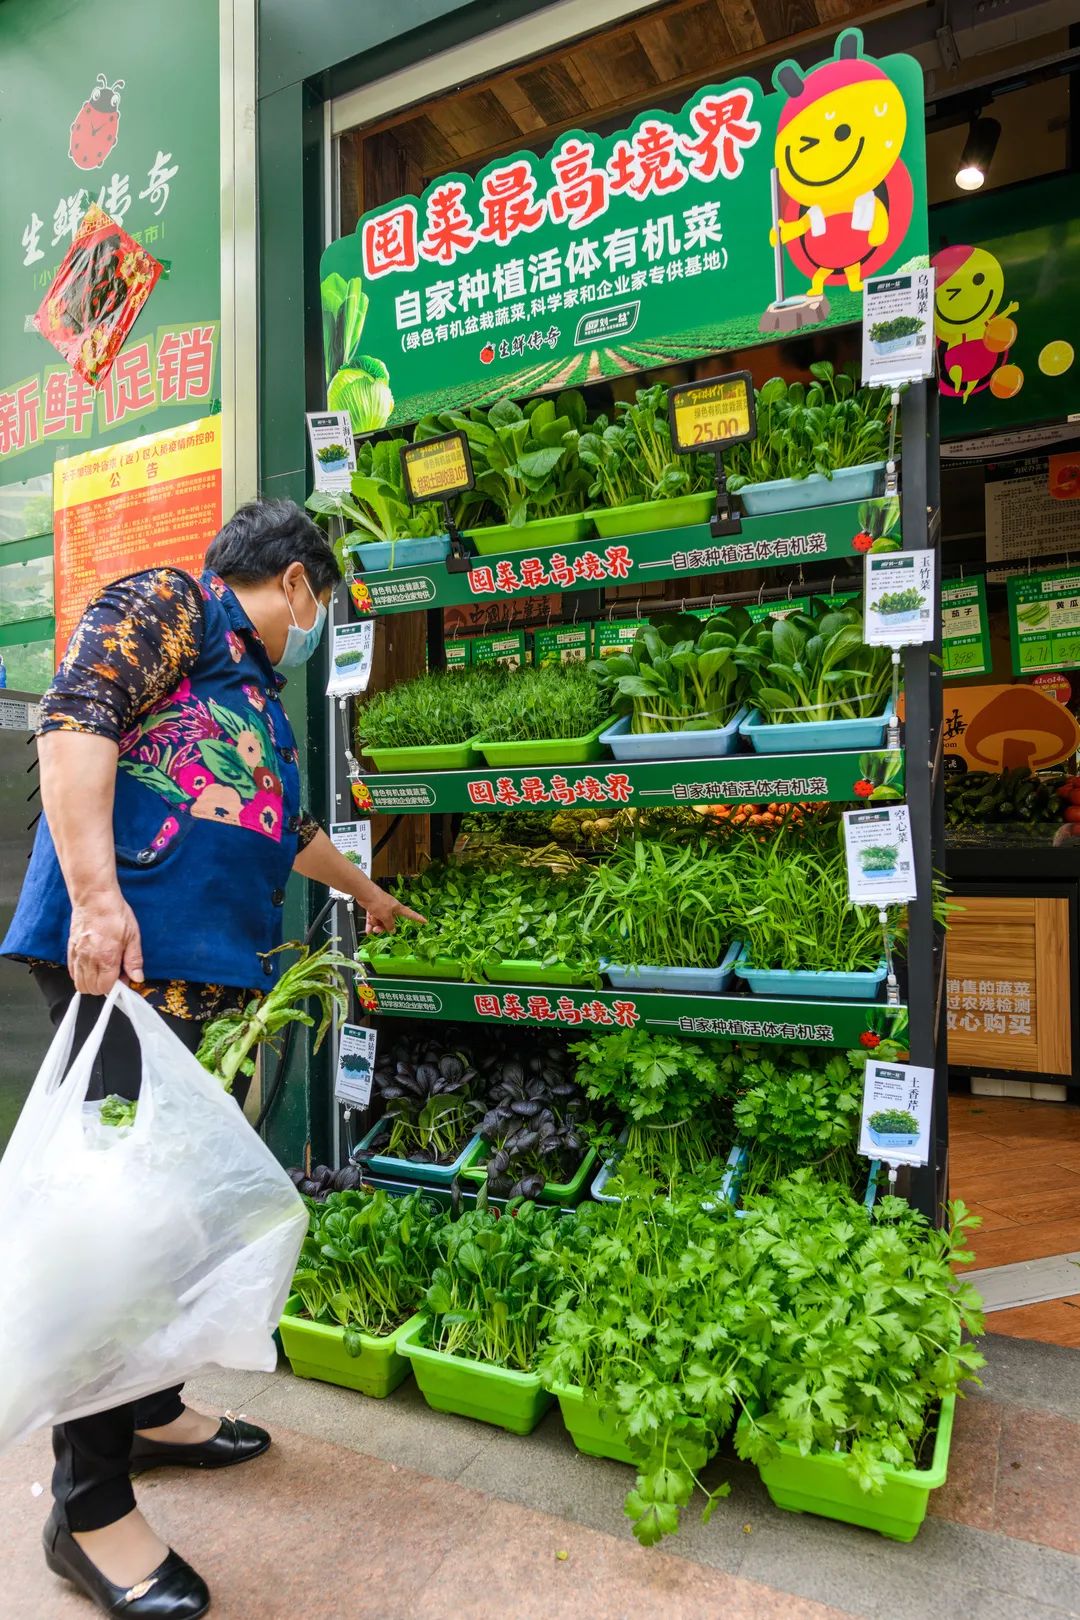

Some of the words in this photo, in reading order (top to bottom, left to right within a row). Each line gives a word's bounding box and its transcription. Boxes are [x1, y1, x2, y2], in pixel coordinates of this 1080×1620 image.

[363, 89, 760, 279] 囤菜最高境界
[395, 201, 723, 330] 自家种植活体有机菜
[0, 326, 214, 454] 新鲜促销
[951, 608, 973, 618] 茄子
